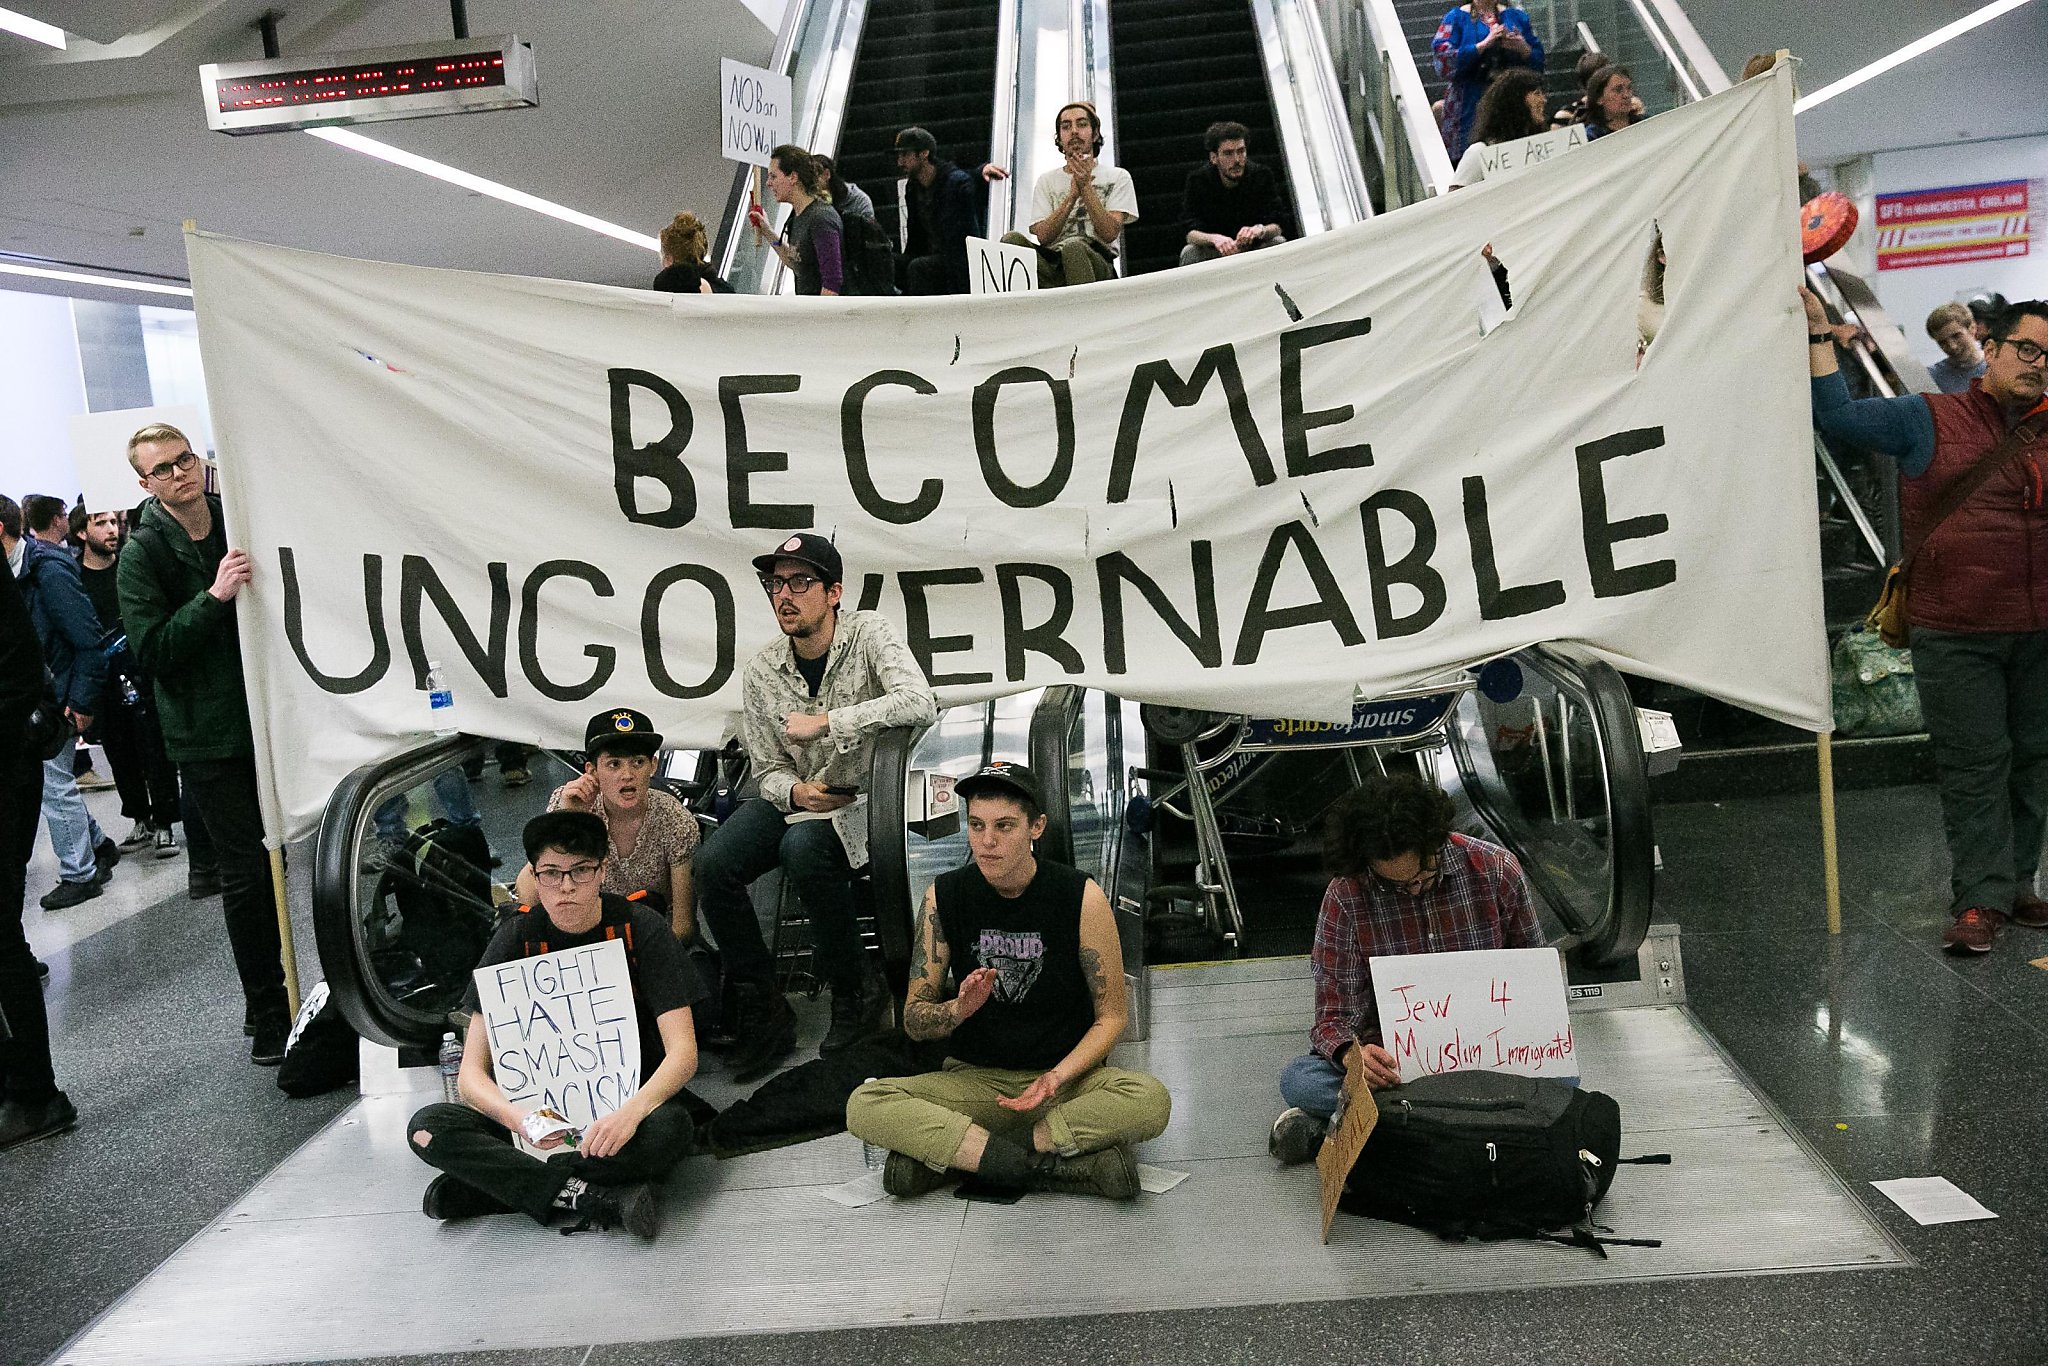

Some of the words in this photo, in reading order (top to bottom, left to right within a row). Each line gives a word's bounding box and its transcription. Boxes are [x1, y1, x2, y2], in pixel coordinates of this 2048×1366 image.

[728, 116, 752, 152] NO
[1480, 147, 1511, 172] WE
[1525, 141, 1554, 164] ARE
[1568, 128, 1582, 147] A
[981, 249, 1031, 294] NO
[607, 317, 1375, 529] BECOME
[979, 935, 1043, 959] PROUD
[496, 947, 605, 1003] FIGHT
[1571, 989, 1583, 997] ES
[1584, 987, 1600, 997] 1119
[489, 985, 627, 1049] HATE
[1391, 984, 1452, 1023] Jew
[1490, 978, 1512, 1016] 4
[499, 1027, 626, 1093] SMASH
[1394, 1027, 1482, 1076] Muslim
[1487, 1023, 1575, 1071] Immigrants!
